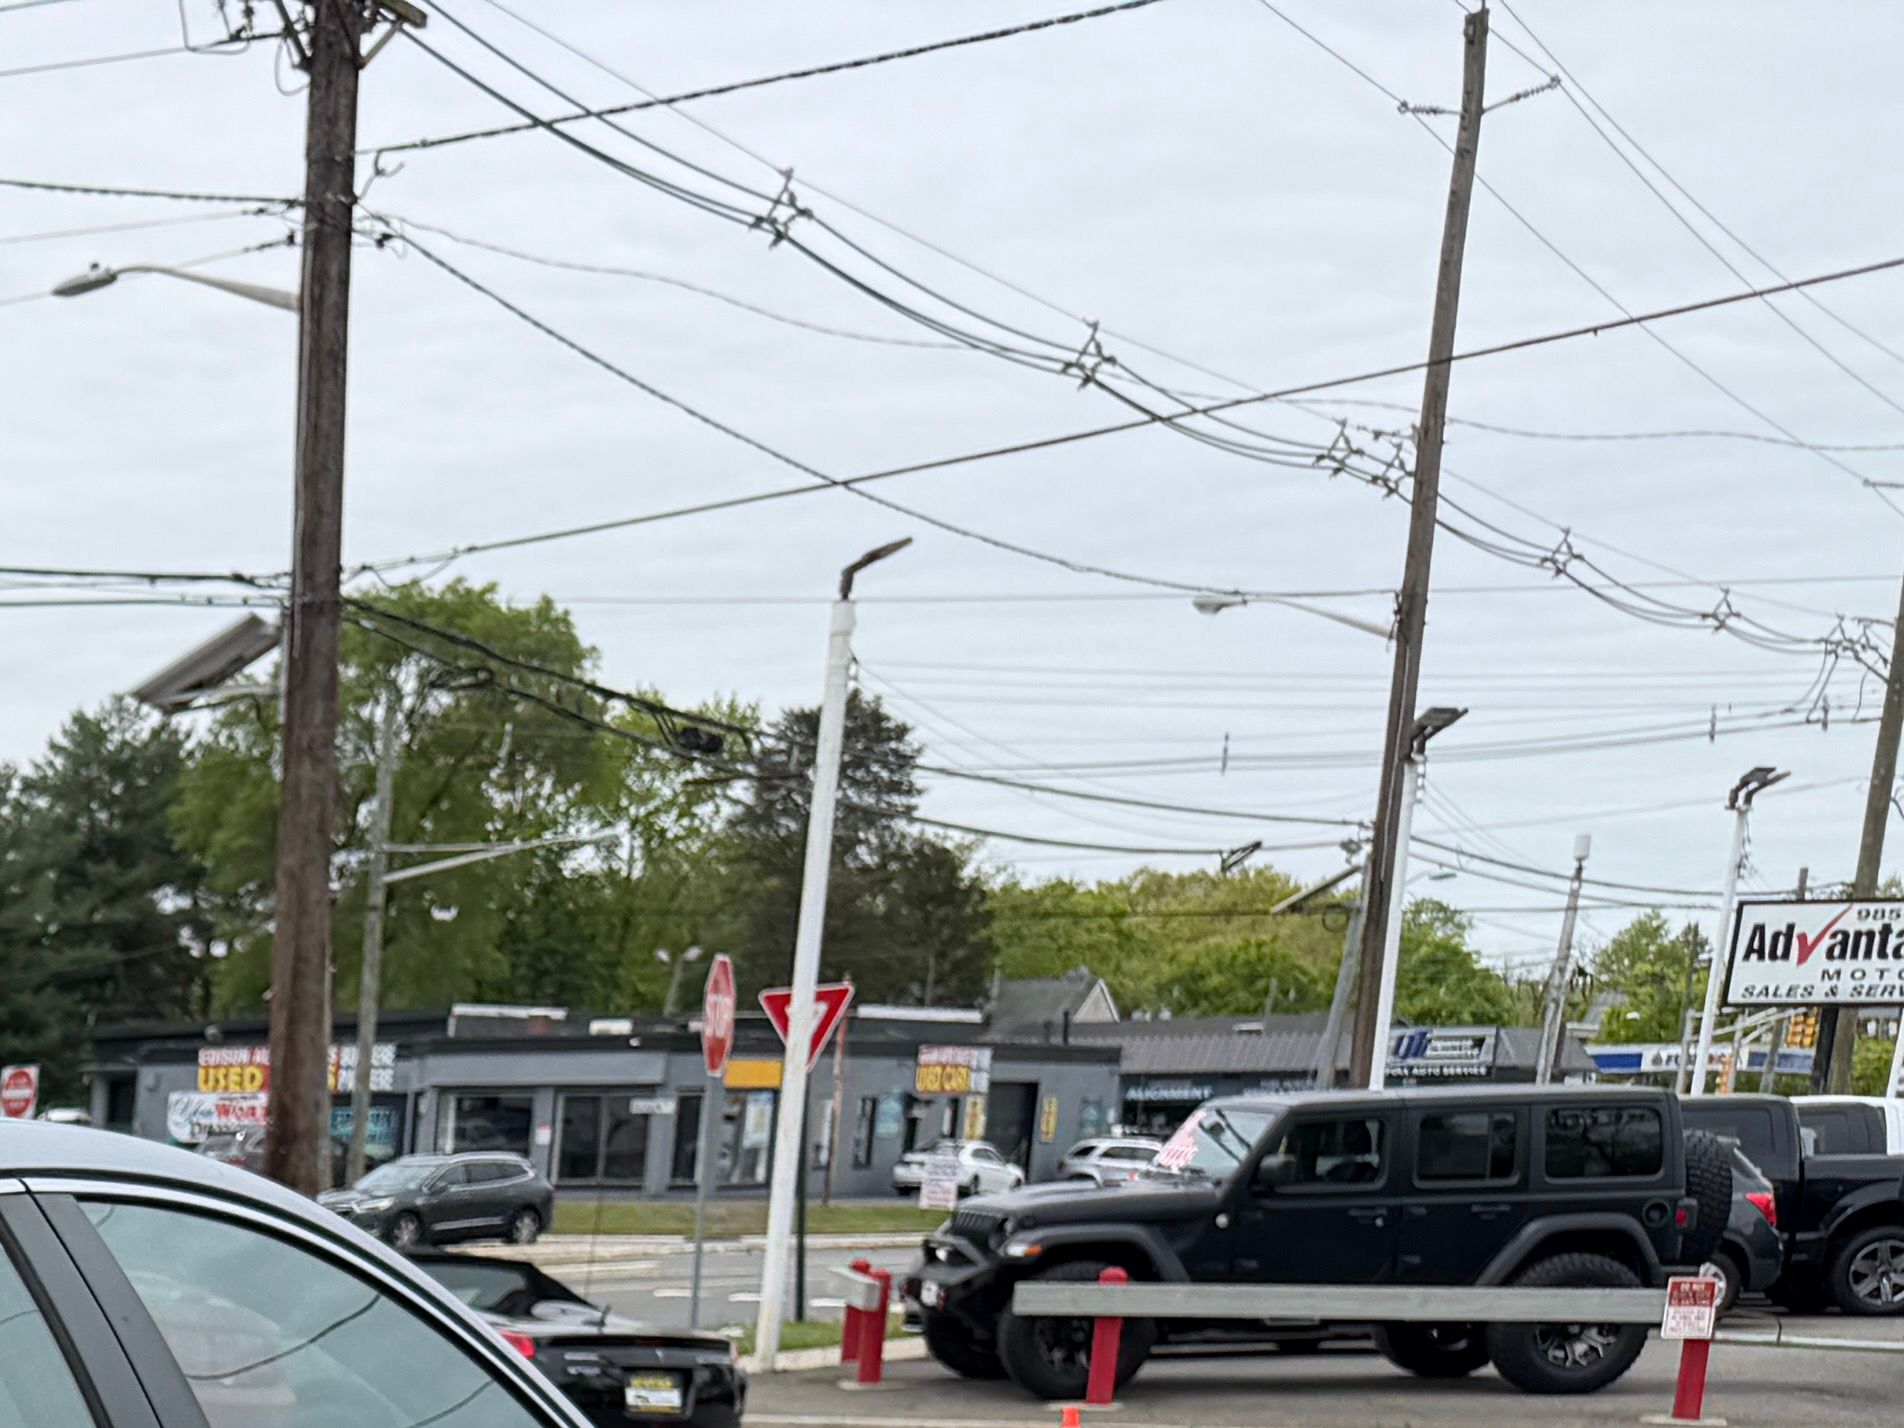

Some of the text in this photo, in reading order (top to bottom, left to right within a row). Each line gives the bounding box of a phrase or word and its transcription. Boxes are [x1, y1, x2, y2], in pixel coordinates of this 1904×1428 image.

[1741, 984, 1815, 999] SALES
[1824, 984, 1839, 998] &
[198, 1065, 264, 1092] USED
